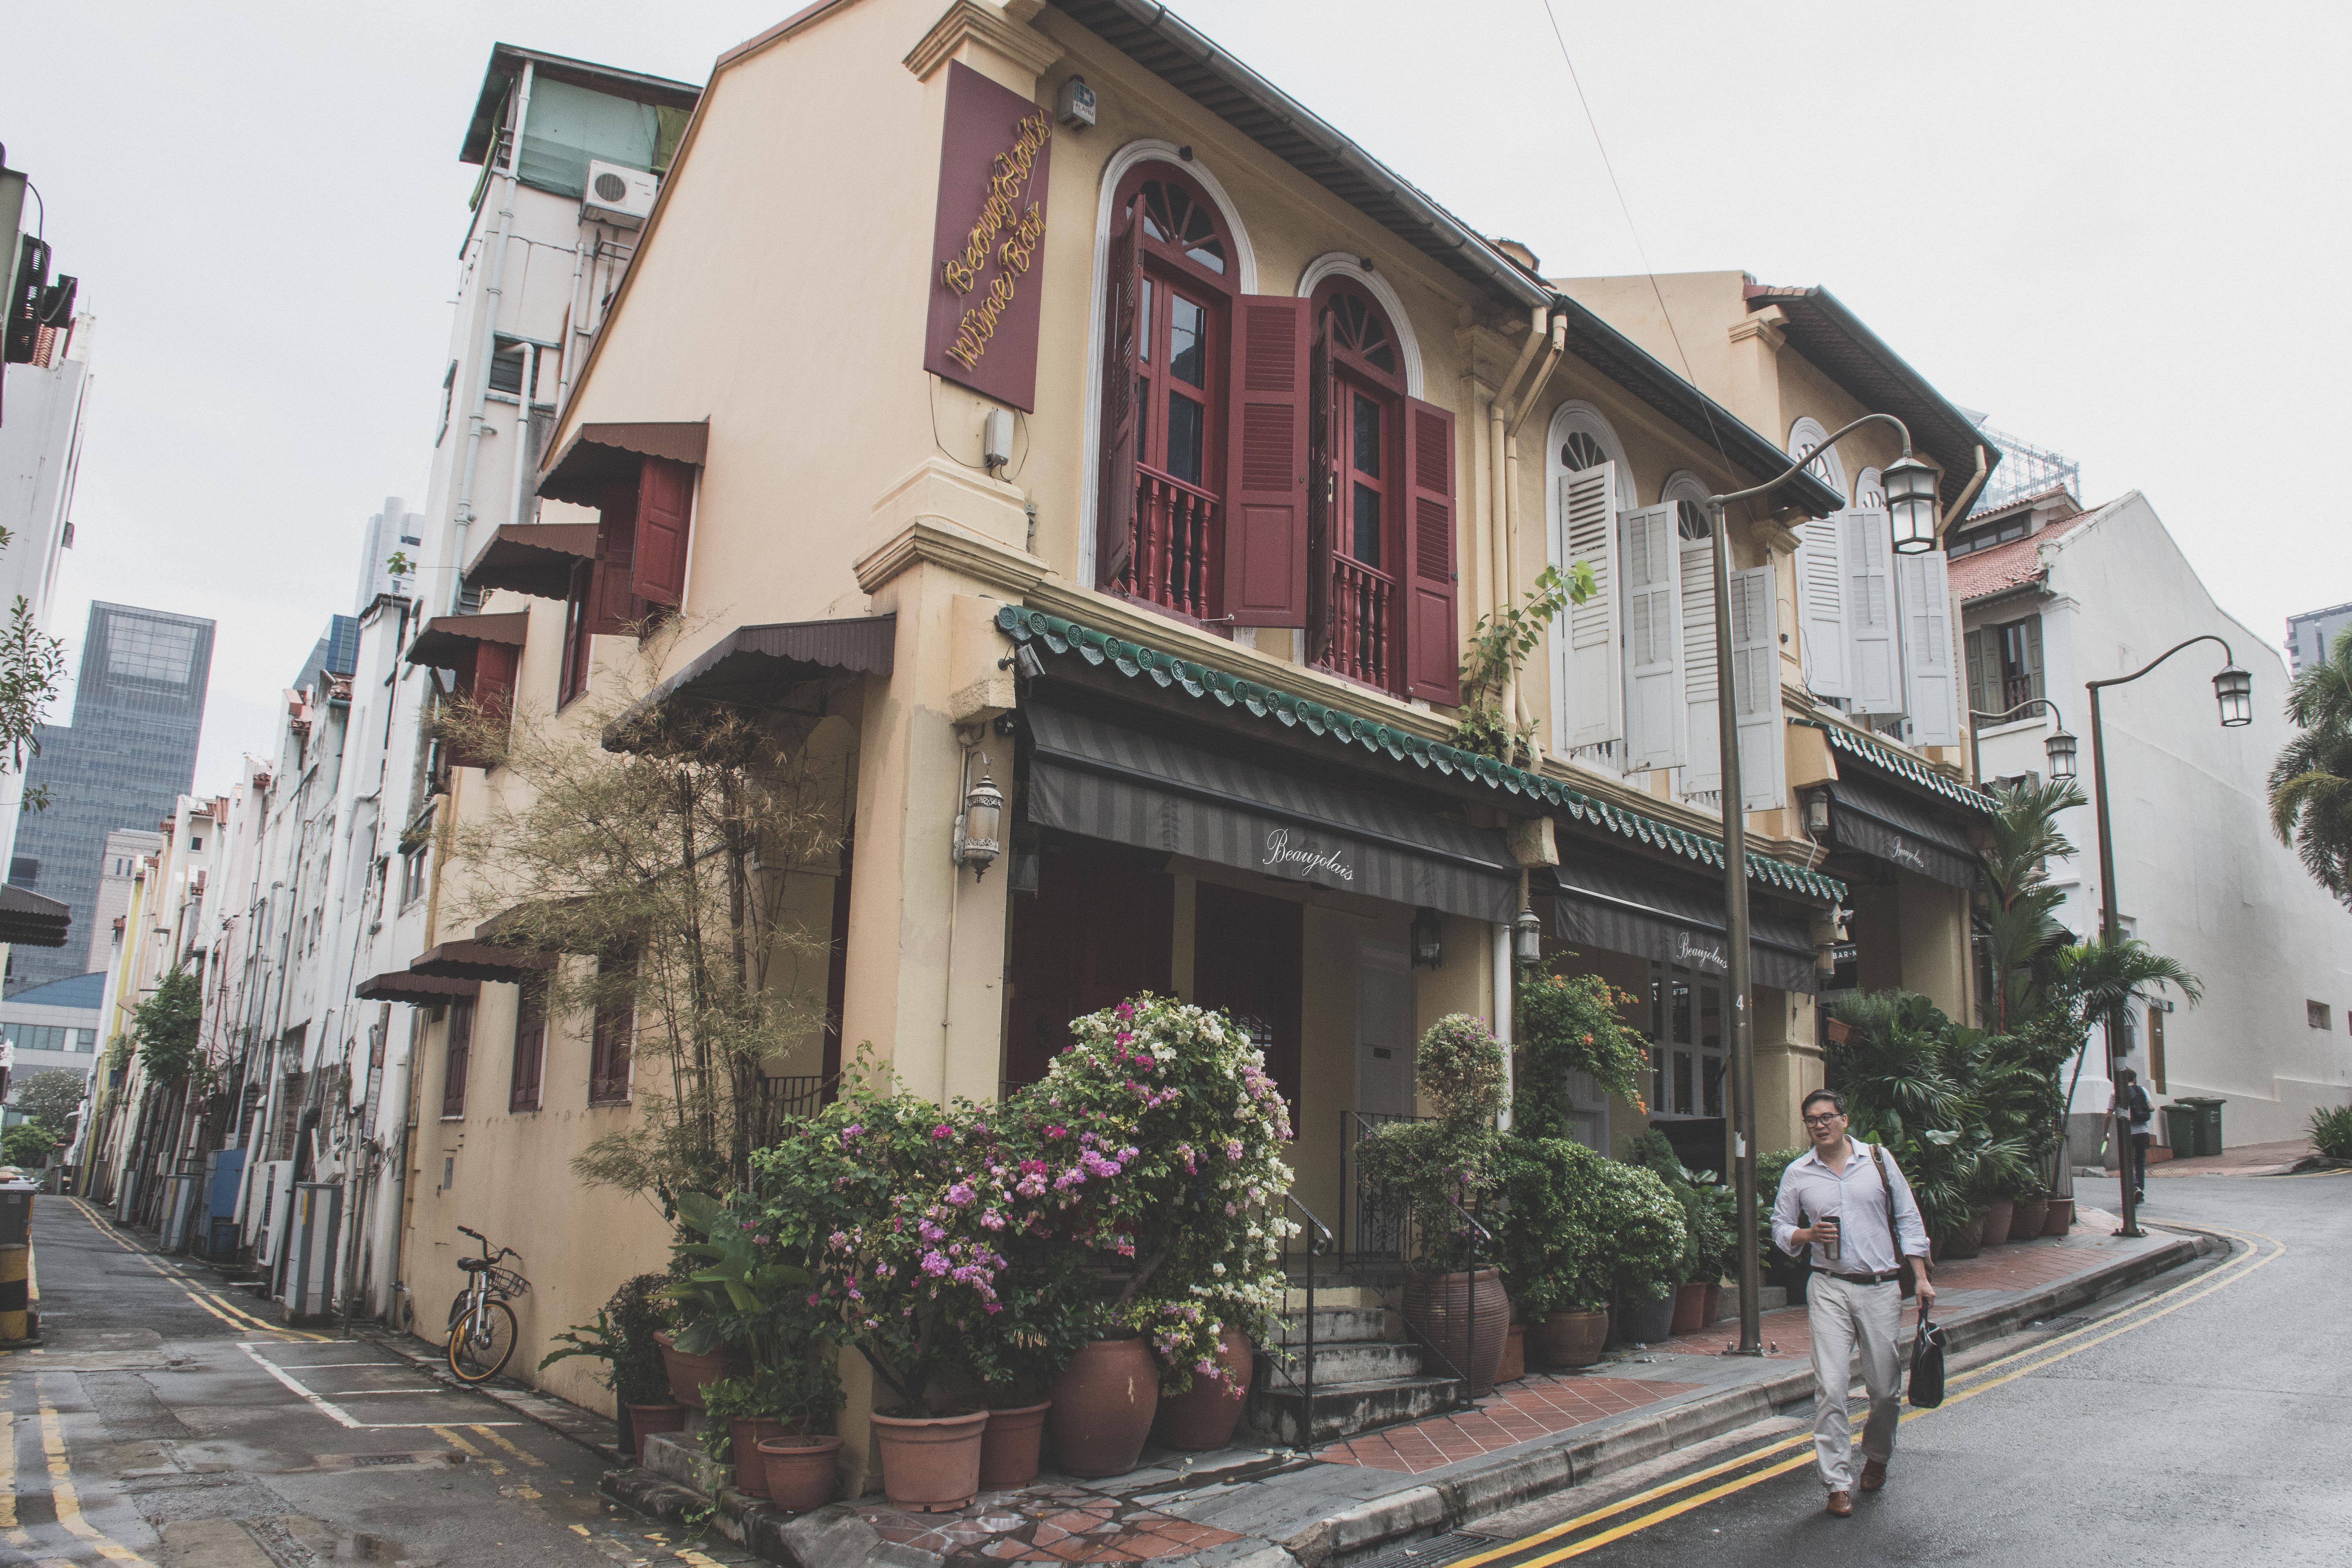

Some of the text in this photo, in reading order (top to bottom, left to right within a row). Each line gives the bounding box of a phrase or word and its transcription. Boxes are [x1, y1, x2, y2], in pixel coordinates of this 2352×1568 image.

[949, 200, 1047, 368] Wine Bar
[1262, 828, 1354, 880] Beaujolais
[1677, 931, 1728, 968] Beaujolais
[1736, 994, 1744, 1011] 4
